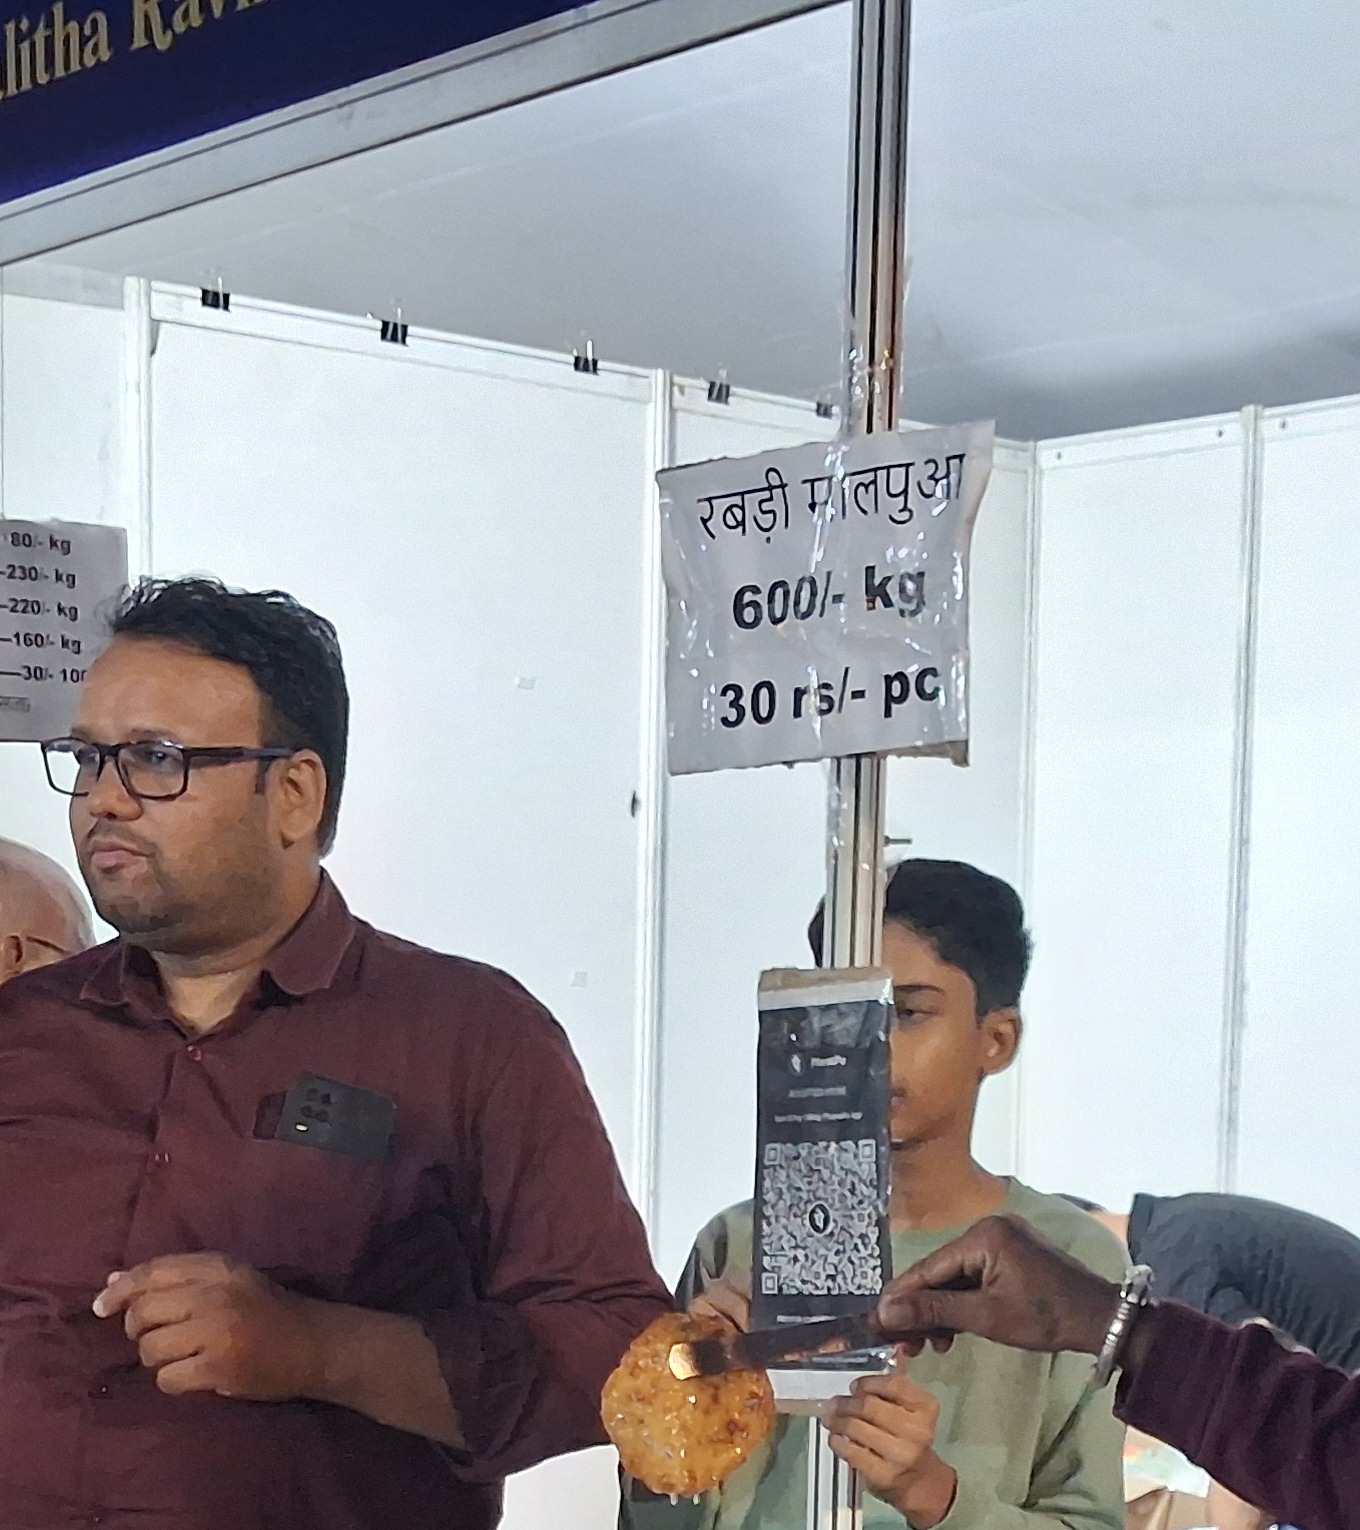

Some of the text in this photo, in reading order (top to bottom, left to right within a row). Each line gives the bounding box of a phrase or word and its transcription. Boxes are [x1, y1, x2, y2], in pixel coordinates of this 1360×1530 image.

[697, 453, 967, 545] रबड़ी मालपुआ
[49, 534, 71, 556] kg
[55, 568, 76, 589] kg
[733, 565, 927, 630] 600/- kg
[57, 602, 78, 622] kg
[61, 634, 81, 655] kg
[719, 665, 941, 728] 30 rs/- pc
